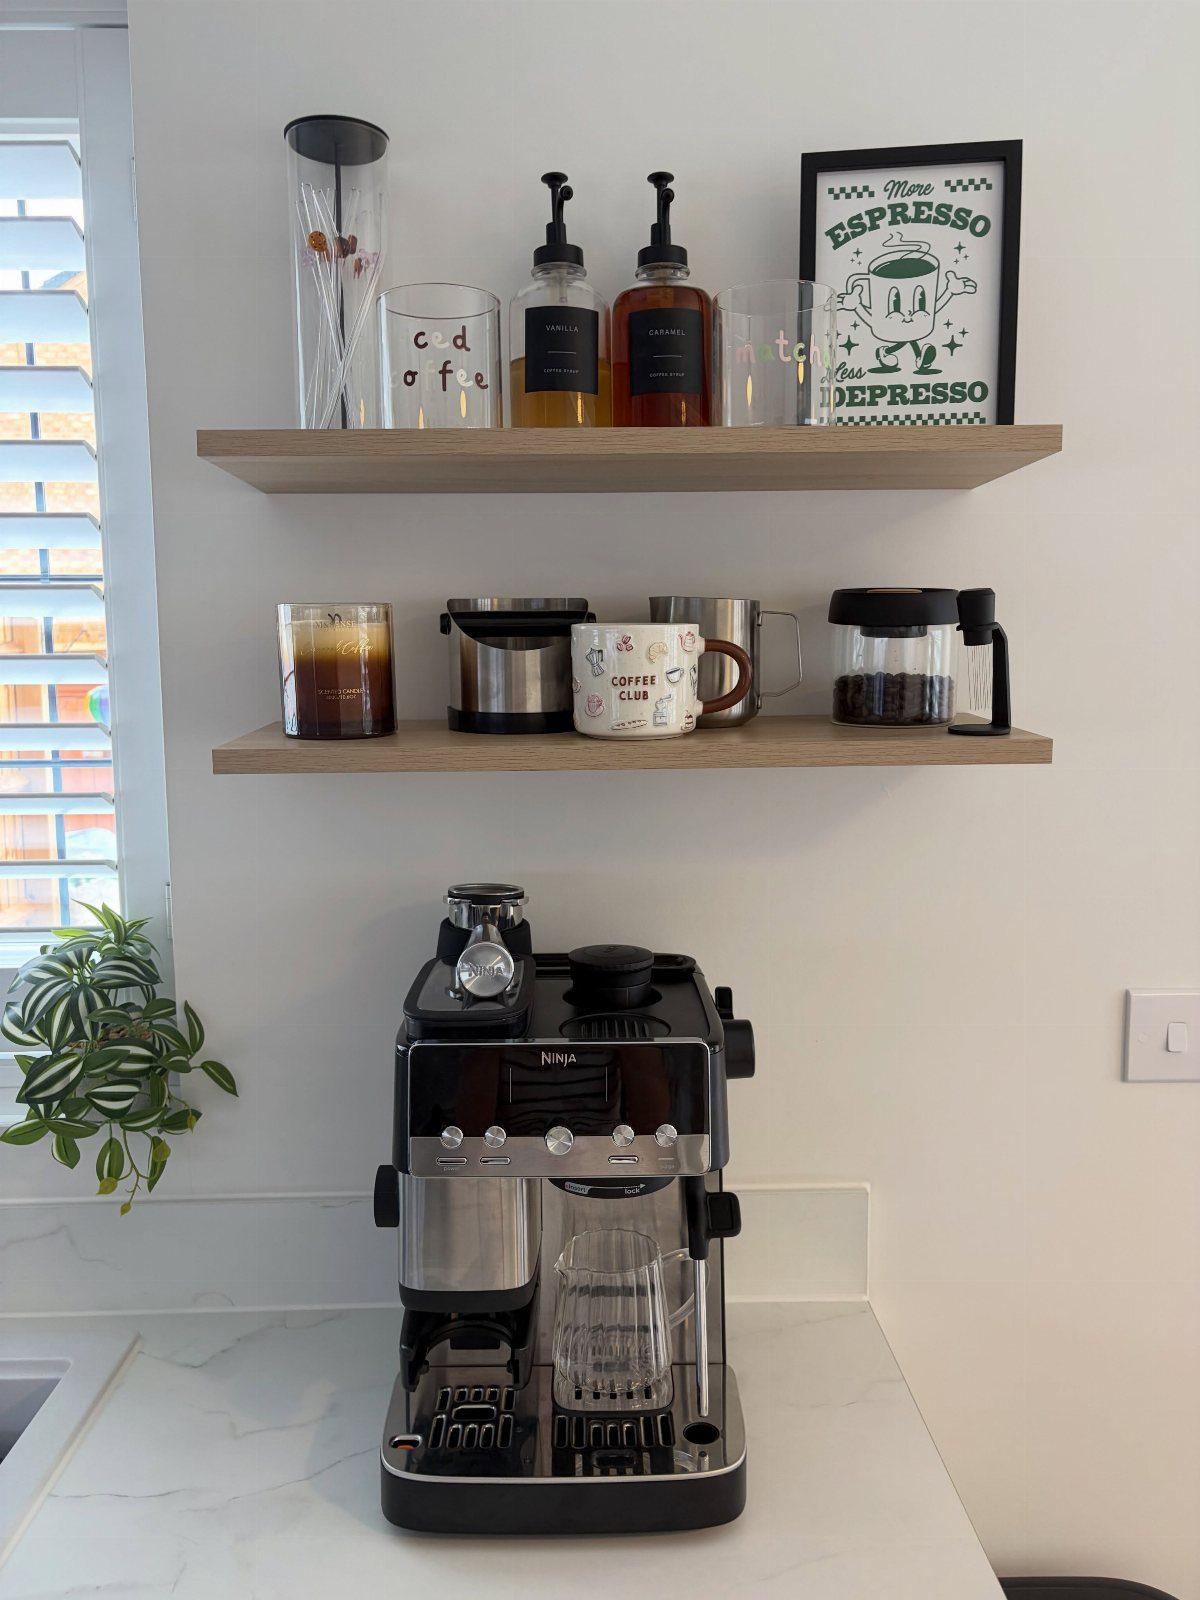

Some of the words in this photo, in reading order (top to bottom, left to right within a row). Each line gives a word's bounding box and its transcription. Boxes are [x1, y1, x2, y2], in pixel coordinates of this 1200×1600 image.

[883, 179, 935, 200] More
[824, 201, 992, 251] ESPRESSO
[545, 324, 579, 333] VANILLA
[648, 328, 686, 336] CARAMEL
[820, 381, 989, 408] DEPRESSO
[611, 676, 656, 687] COFFEE
[619, 691, 649, 701] CLUB
[541, 1051, 577, 1067] NINJA
